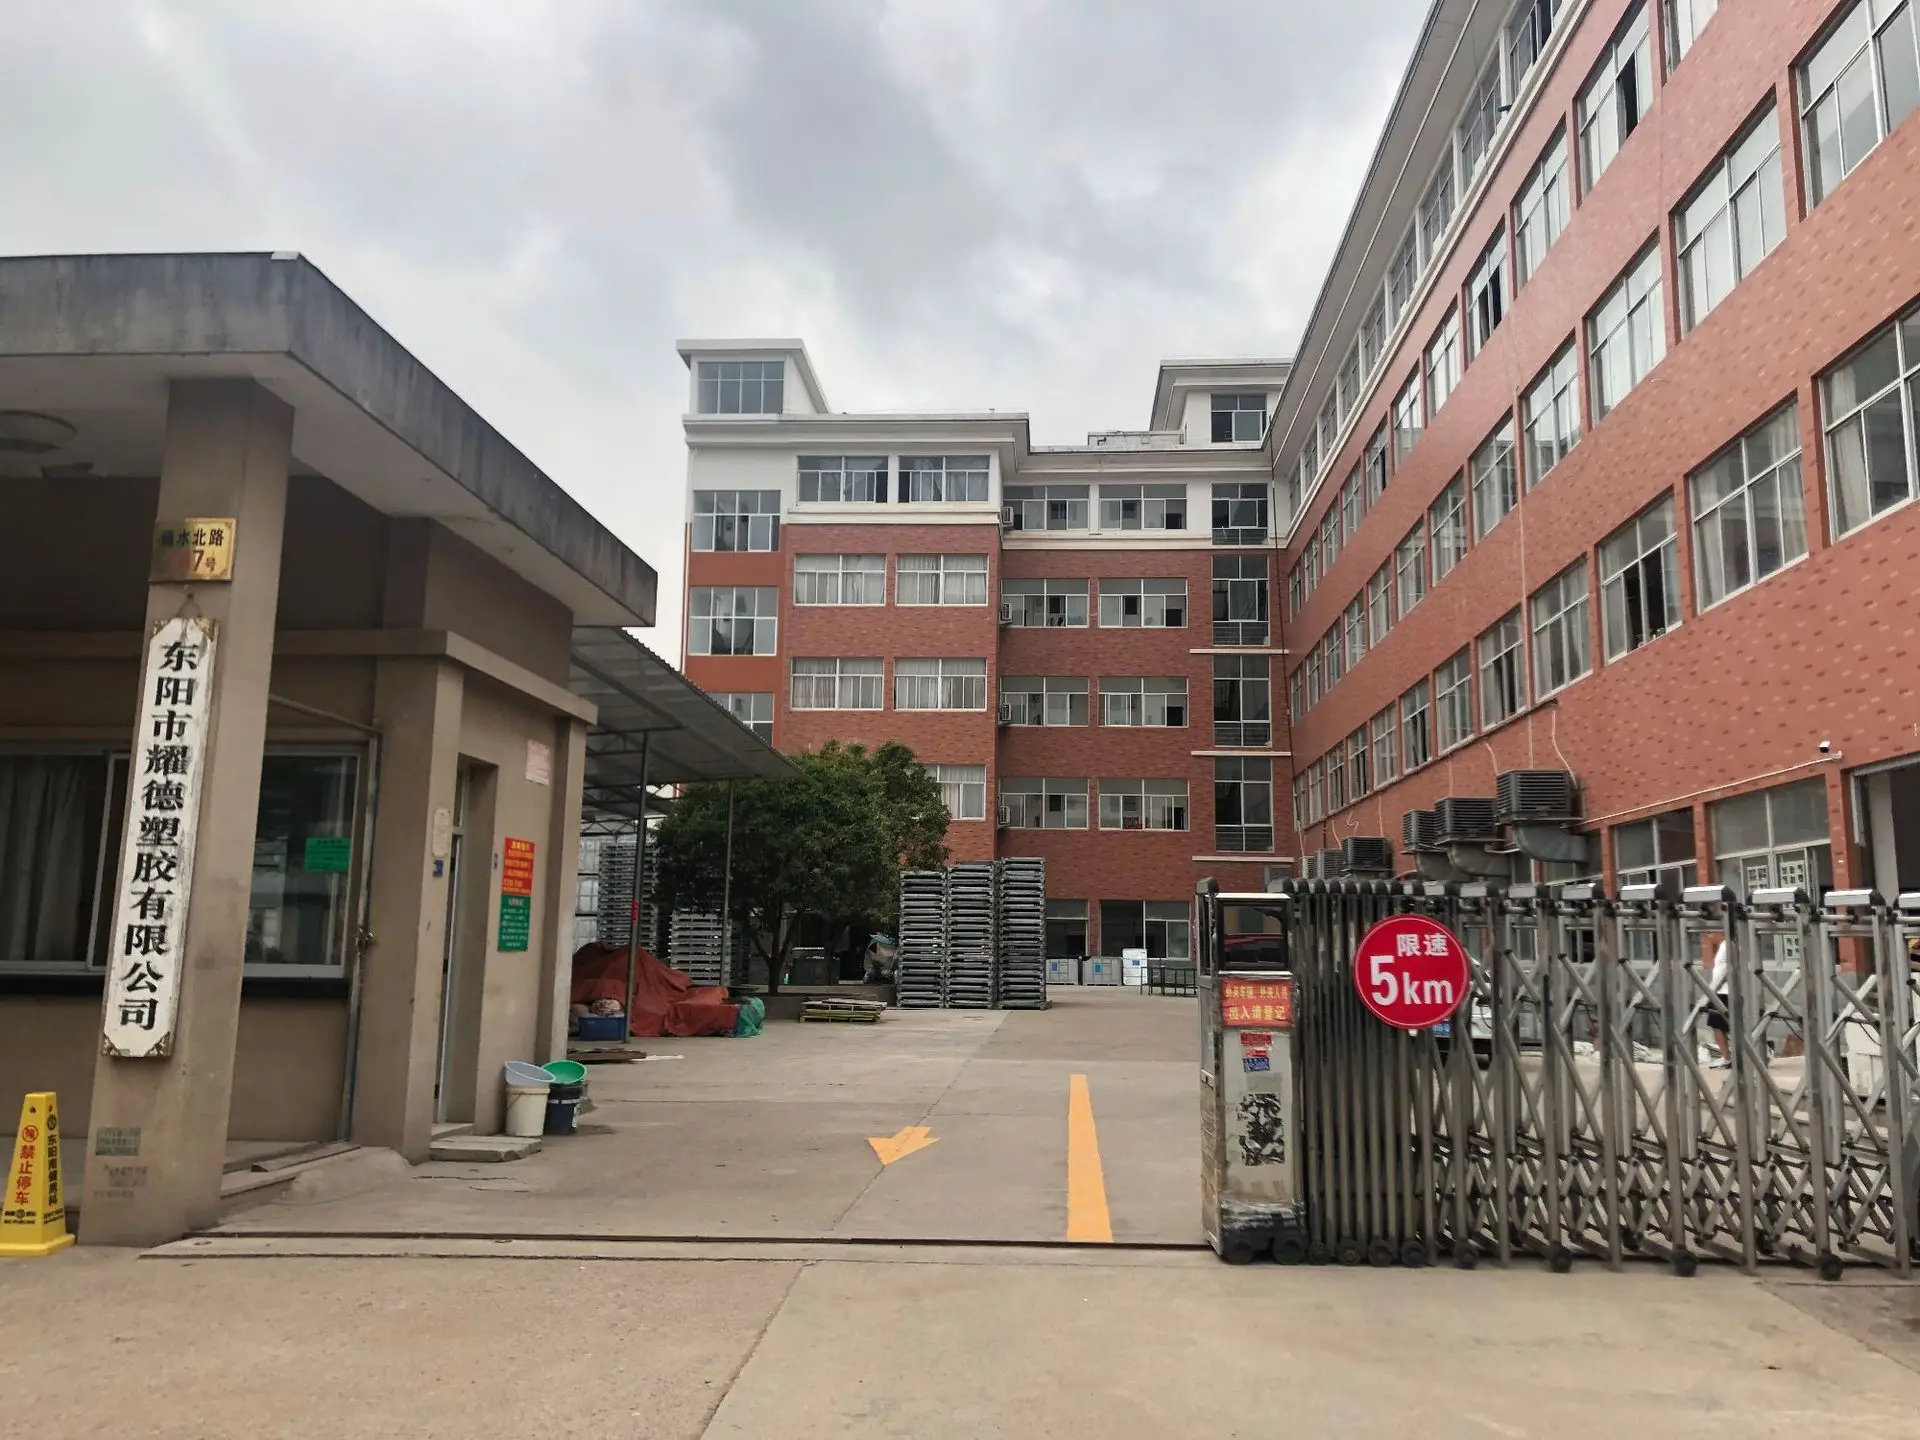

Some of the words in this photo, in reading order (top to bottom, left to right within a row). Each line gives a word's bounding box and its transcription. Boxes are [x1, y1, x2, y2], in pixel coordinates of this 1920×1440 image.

[118, 640, 200, 1031] 东阳市耀德塑胶有限公司
[1396, 932, 1449, 956] 限速
[1229, 1004, 1287, 1020] 出入请登记
[14, 1144, 36, 1206] 禁止停车
